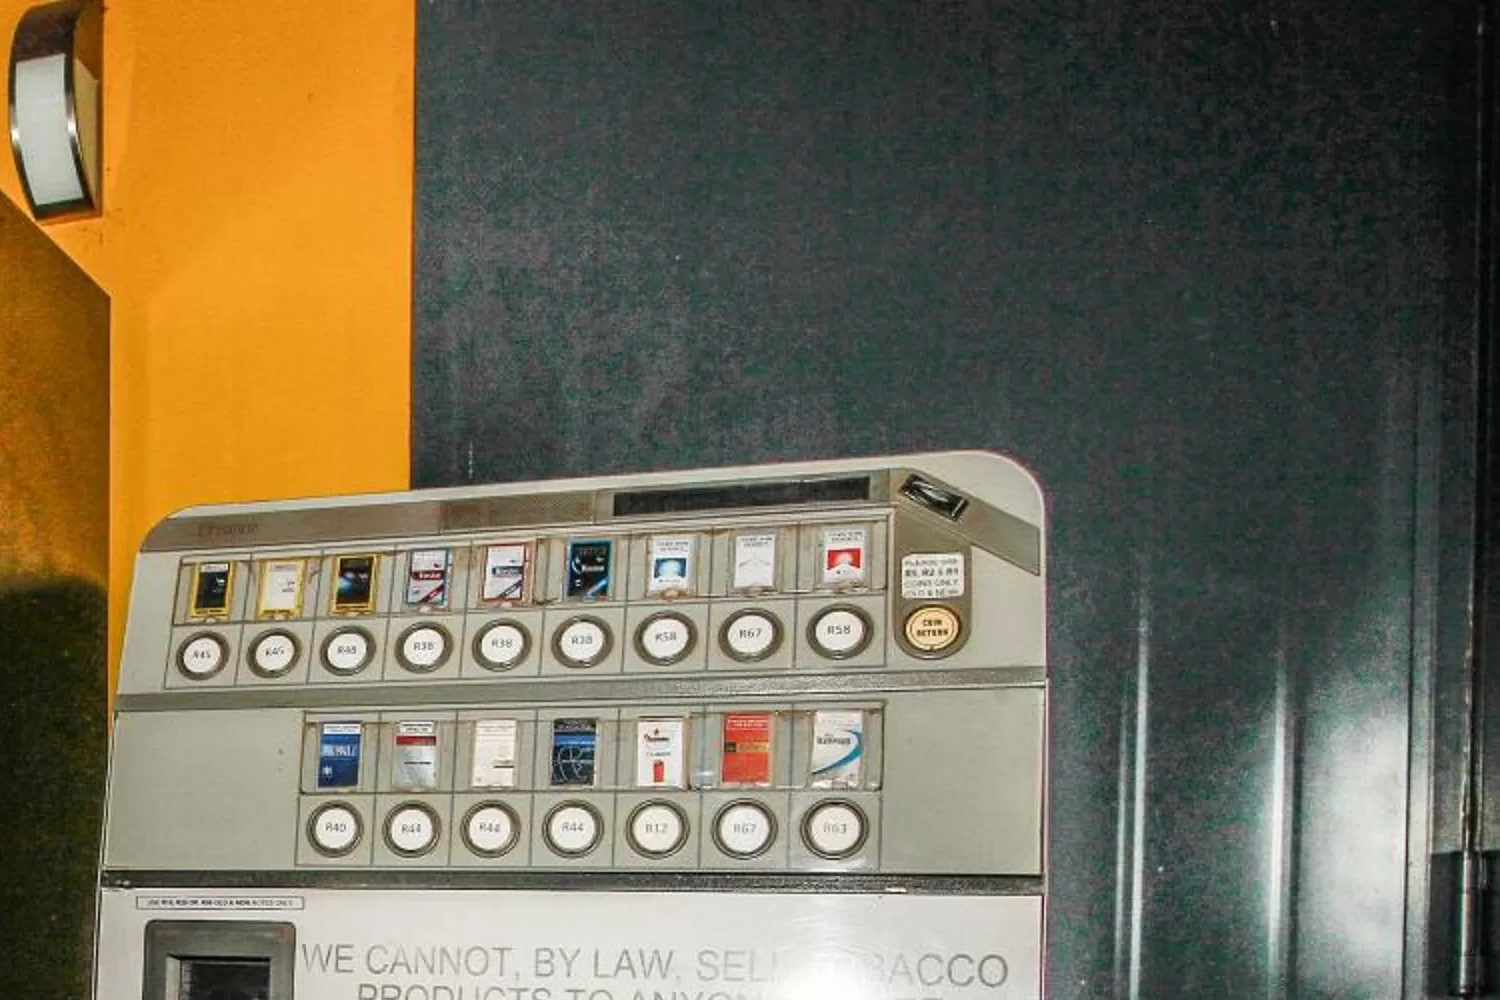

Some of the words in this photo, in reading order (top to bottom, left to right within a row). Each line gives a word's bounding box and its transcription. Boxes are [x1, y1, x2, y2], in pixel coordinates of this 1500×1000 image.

[302, 943, 355, 974] WE
[365, 944, 520, 981] CANNOT,
[534, 946, 580, 978] BY
[593, 948, 681, 984] LAW,
